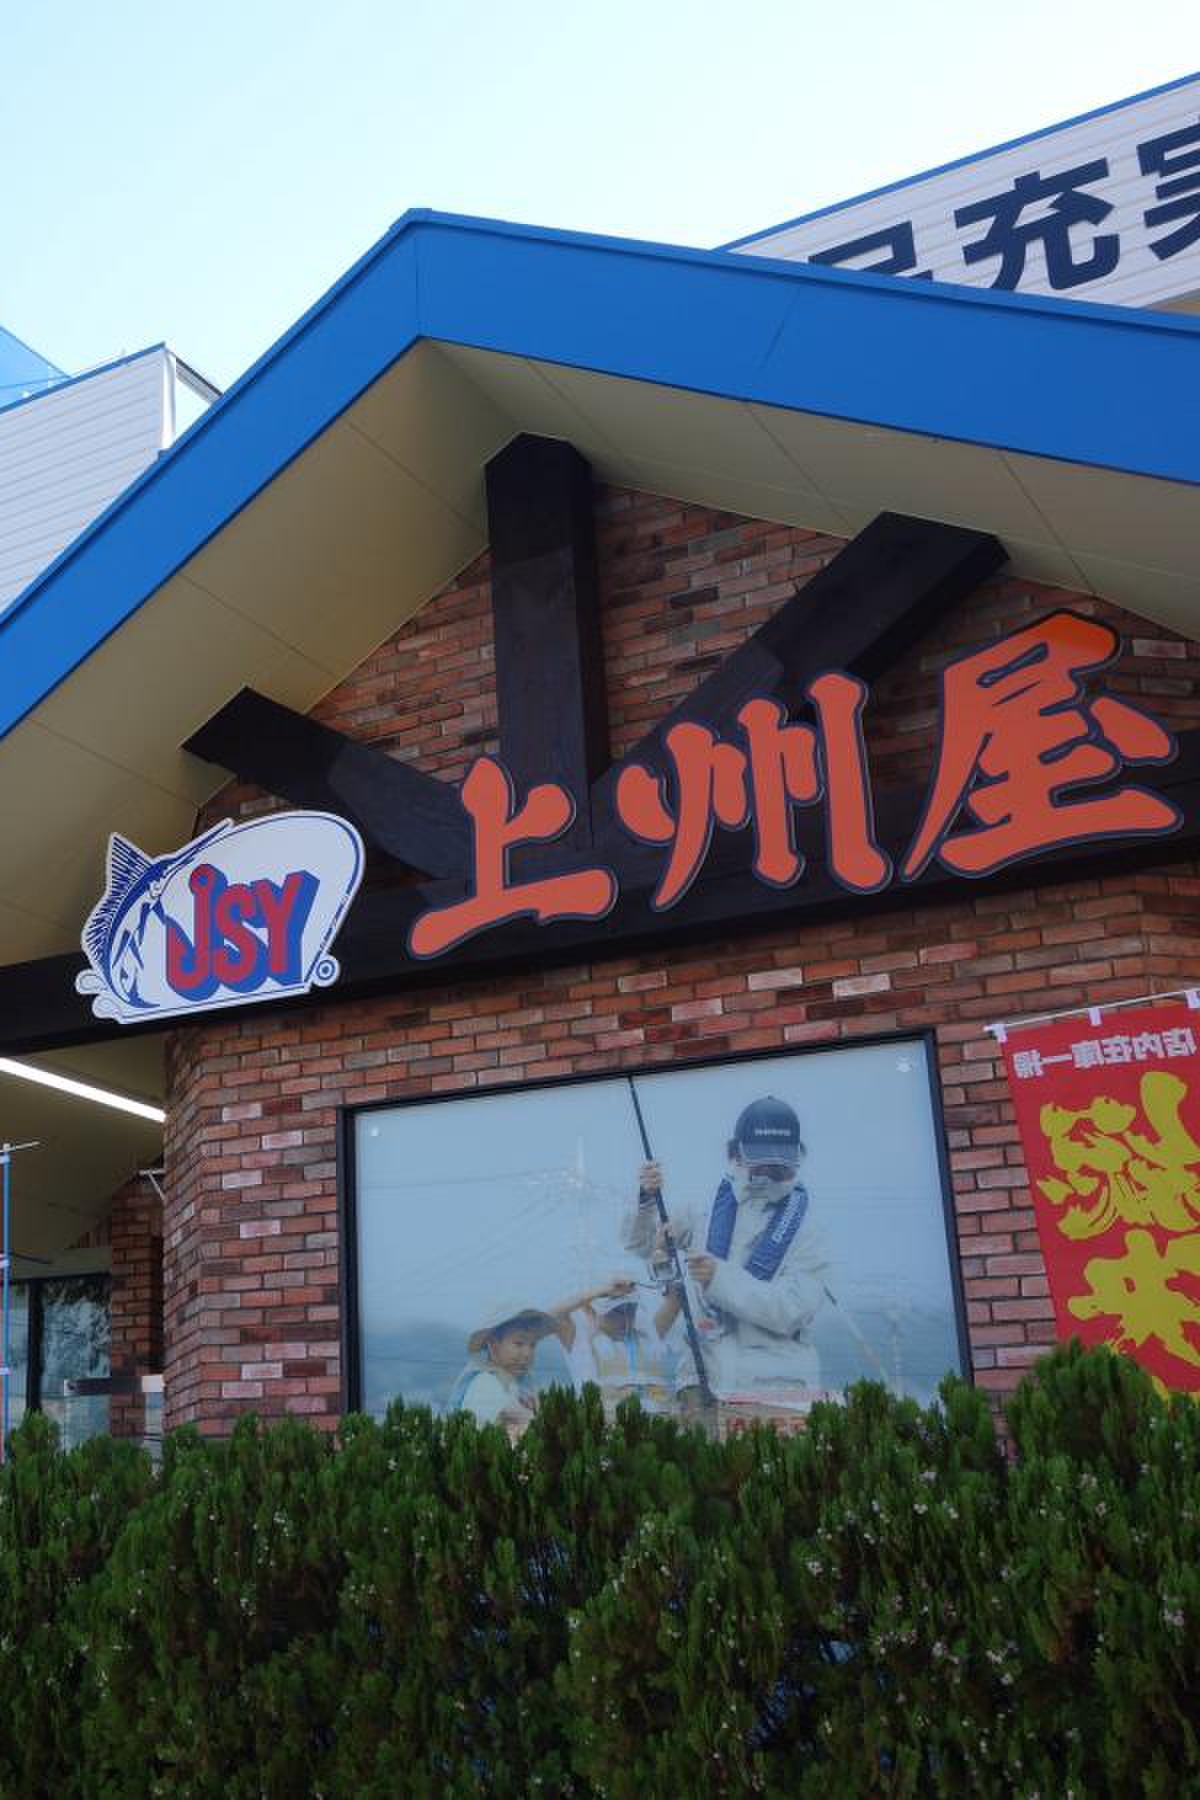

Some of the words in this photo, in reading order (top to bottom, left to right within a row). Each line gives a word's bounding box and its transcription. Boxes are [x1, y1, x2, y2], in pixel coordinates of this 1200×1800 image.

[408, 608, 1184, 961] 上州屋
[165, 863, 320, 1001] JSY
